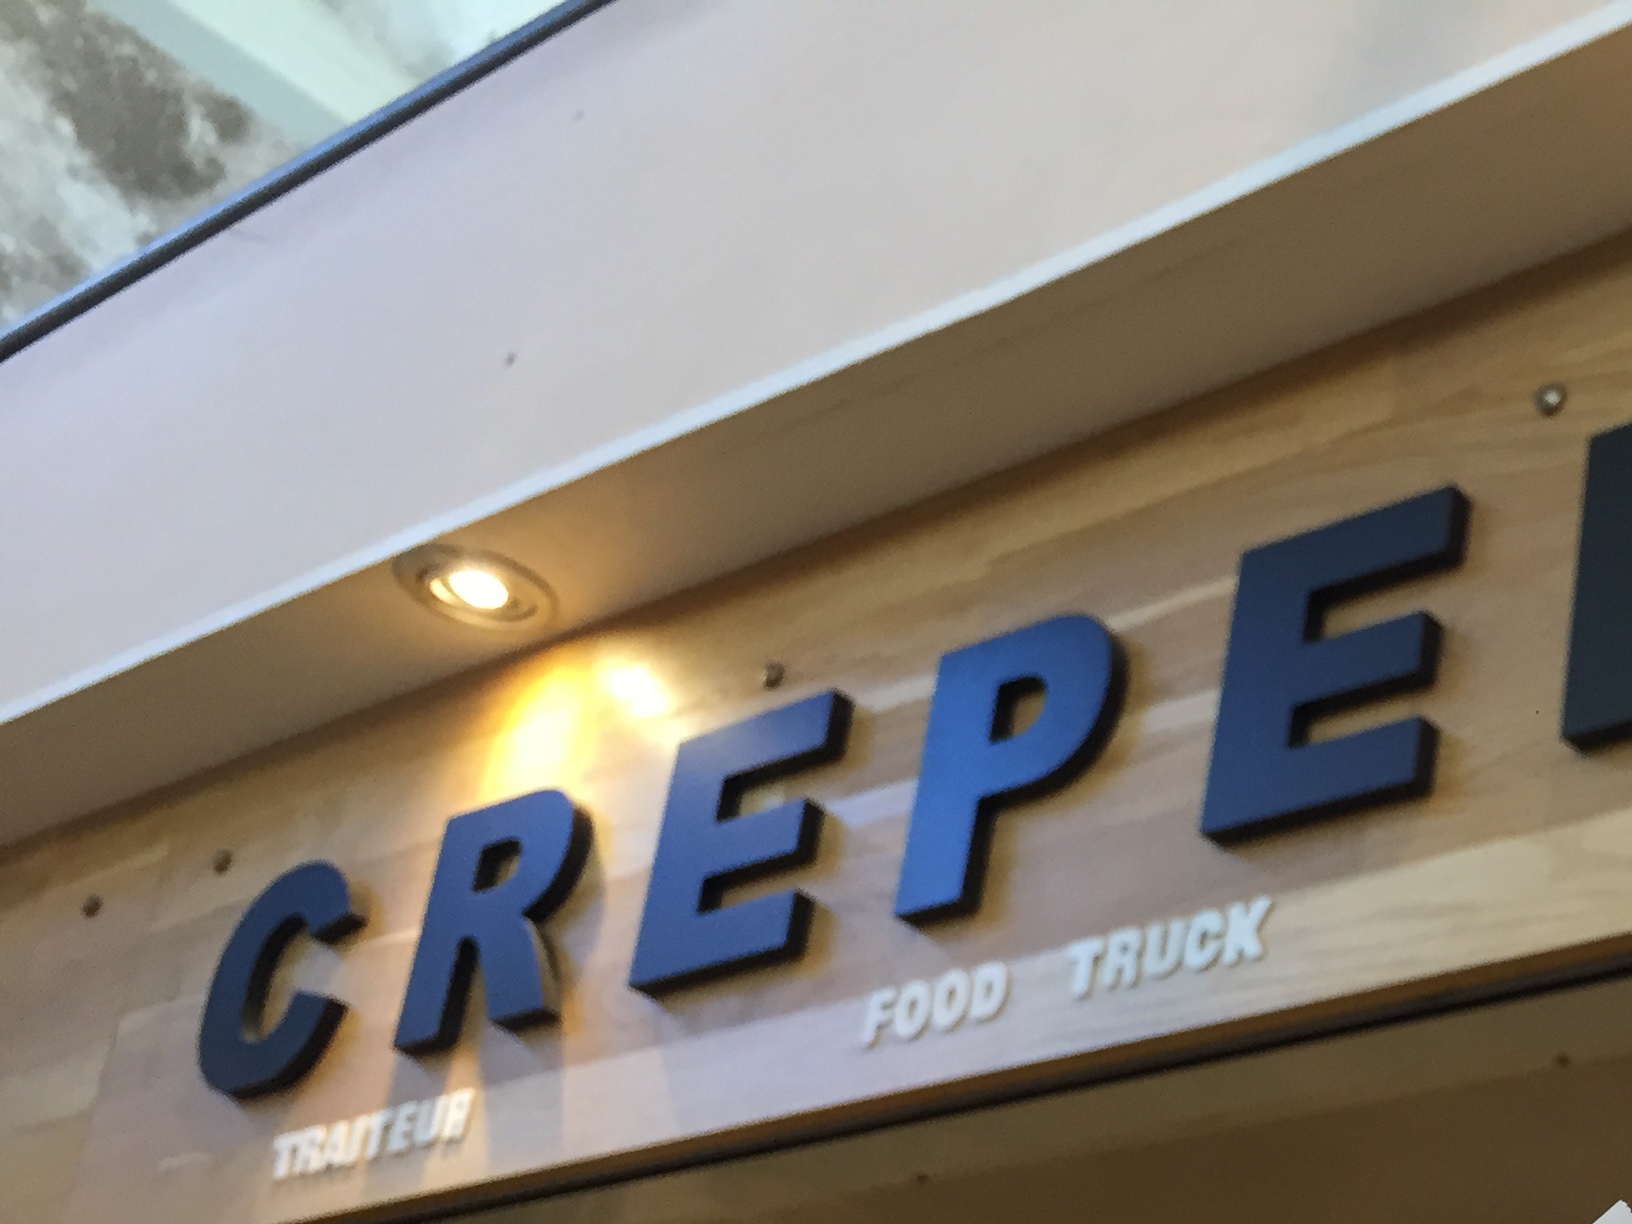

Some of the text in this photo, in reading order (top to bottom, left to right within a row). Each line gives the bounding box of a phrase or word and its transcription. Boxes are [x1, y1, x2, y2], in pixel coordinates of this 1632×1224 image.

[862, 895, 1273, 1048] FOOD TRUCK
[272, 1087, 476, 1181] TRAITEUR
